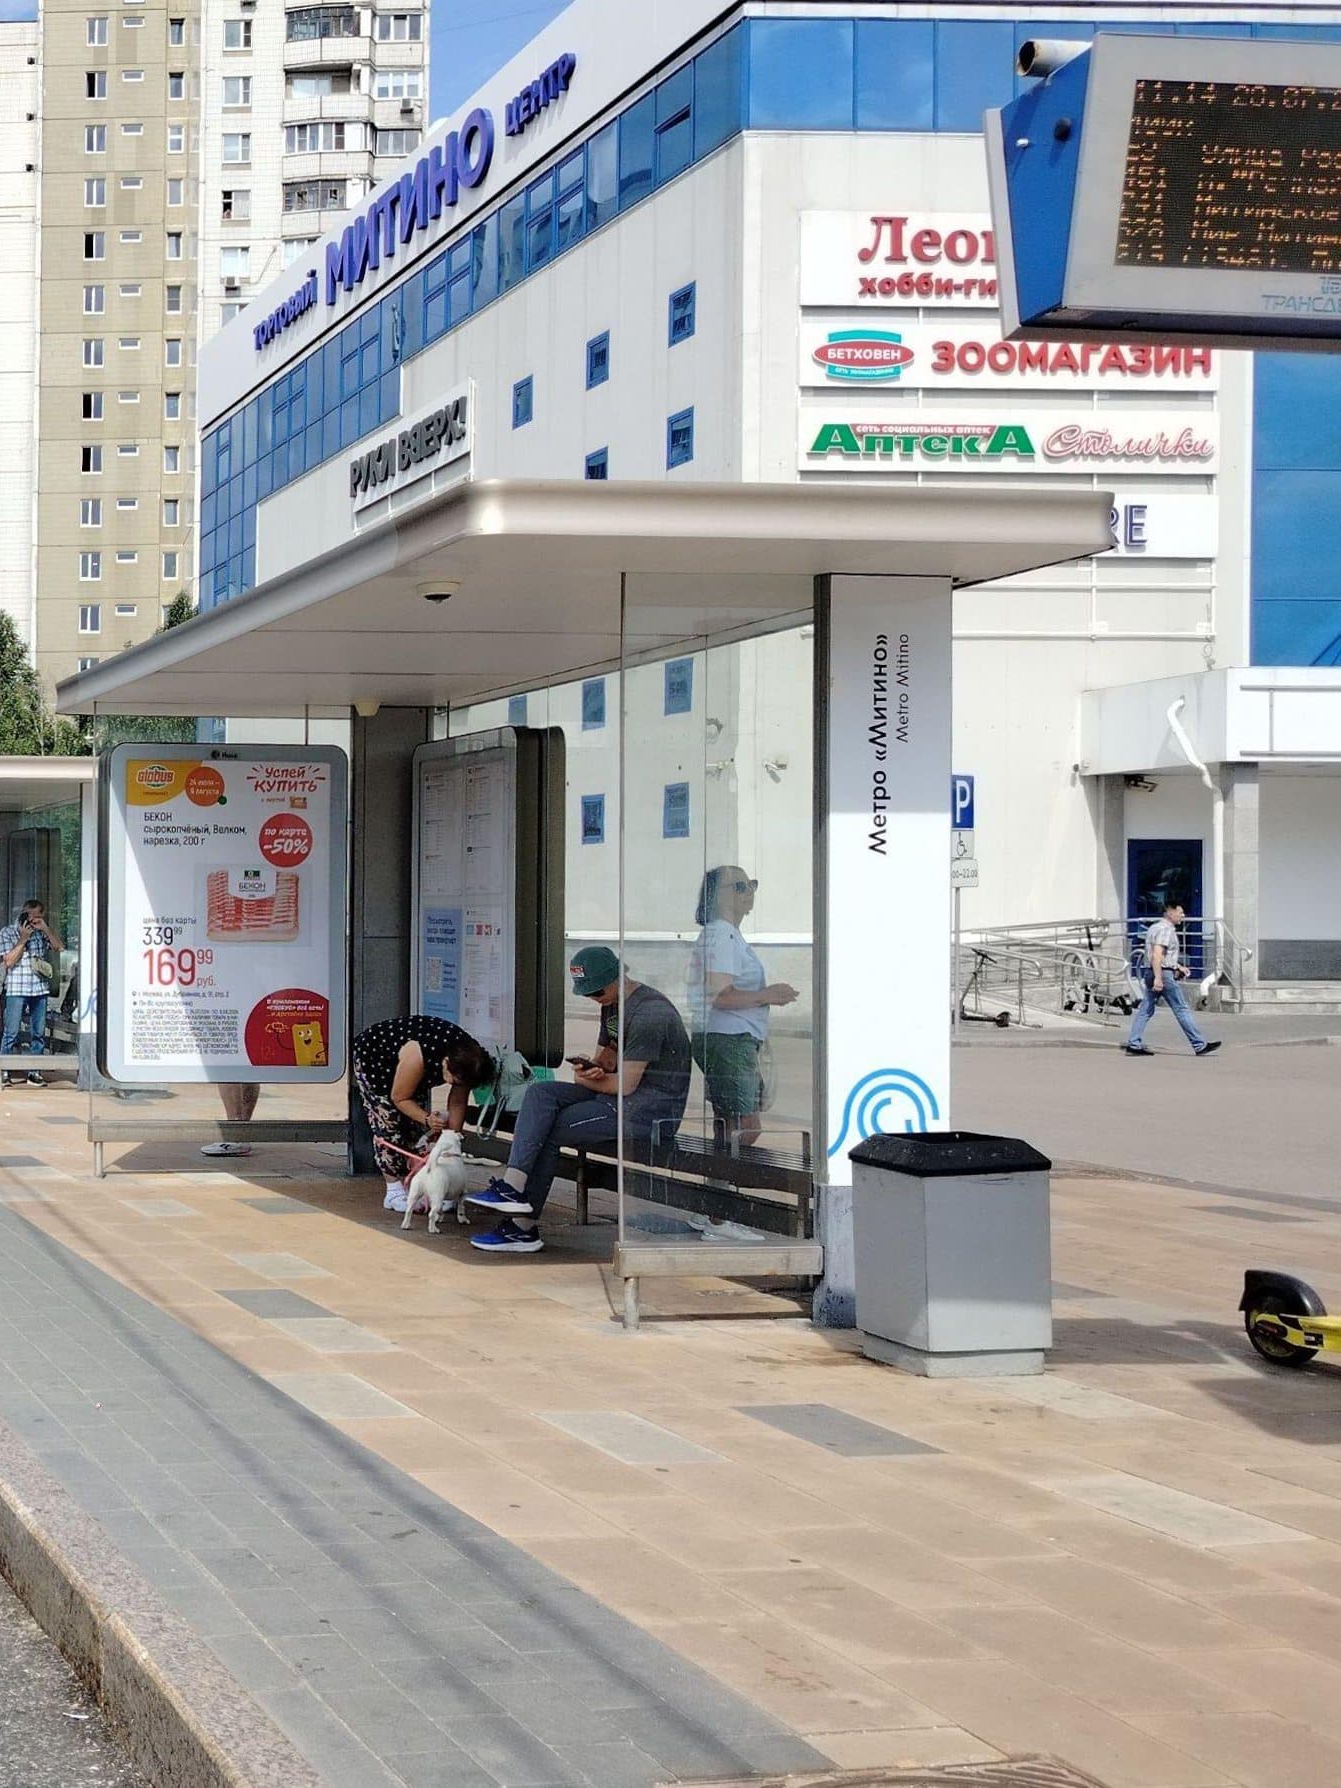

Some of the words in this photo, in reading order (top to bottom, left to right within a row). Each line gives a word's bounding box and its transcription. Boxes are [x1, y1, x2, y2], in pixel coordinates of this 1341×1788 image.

[253, 269, 318, 350] ТОРГОВЫЙ
[326, 108, 494, 305] МИТИНО
[505, 52, 576, 136] ЦЕНТР
[827, 348, 901, 360] БЕТХОВЕН
[931, 340, 1212, 375] ЗООМАГАЗИН
[856, 425, 880, 433] сеть
[882, 426, 953, 435] социальных
[957, 426, 991, 434] аптек
[1044, 424, 1213, 457] Столички
[350, 438, 397, 497] РУКИ
[896, 633, 909, 687] Mitino
[868, 634, 888, 761] «Митино»
[896, 693, 909, 743] Metro
[254, 780, 317, 793] КУПИТЬ
[956, 780, 971, 824] P
[144, 812, 172, 822] БЕКОН
[868, 770, 891, 855] Метро
[264, 828, 277, 836] по
[144, 837, 181, 848] нарезка,
[183, 836, 199, 846] 200
[263, 838, 308, 854] -50%
[176, 918, 196, 926] карты
[143, 927, 174, 945] 339
[197, 949, 214, 965] 99
[143, 948, 196, 986] 169
[197, 976, 217, 988] руб.
